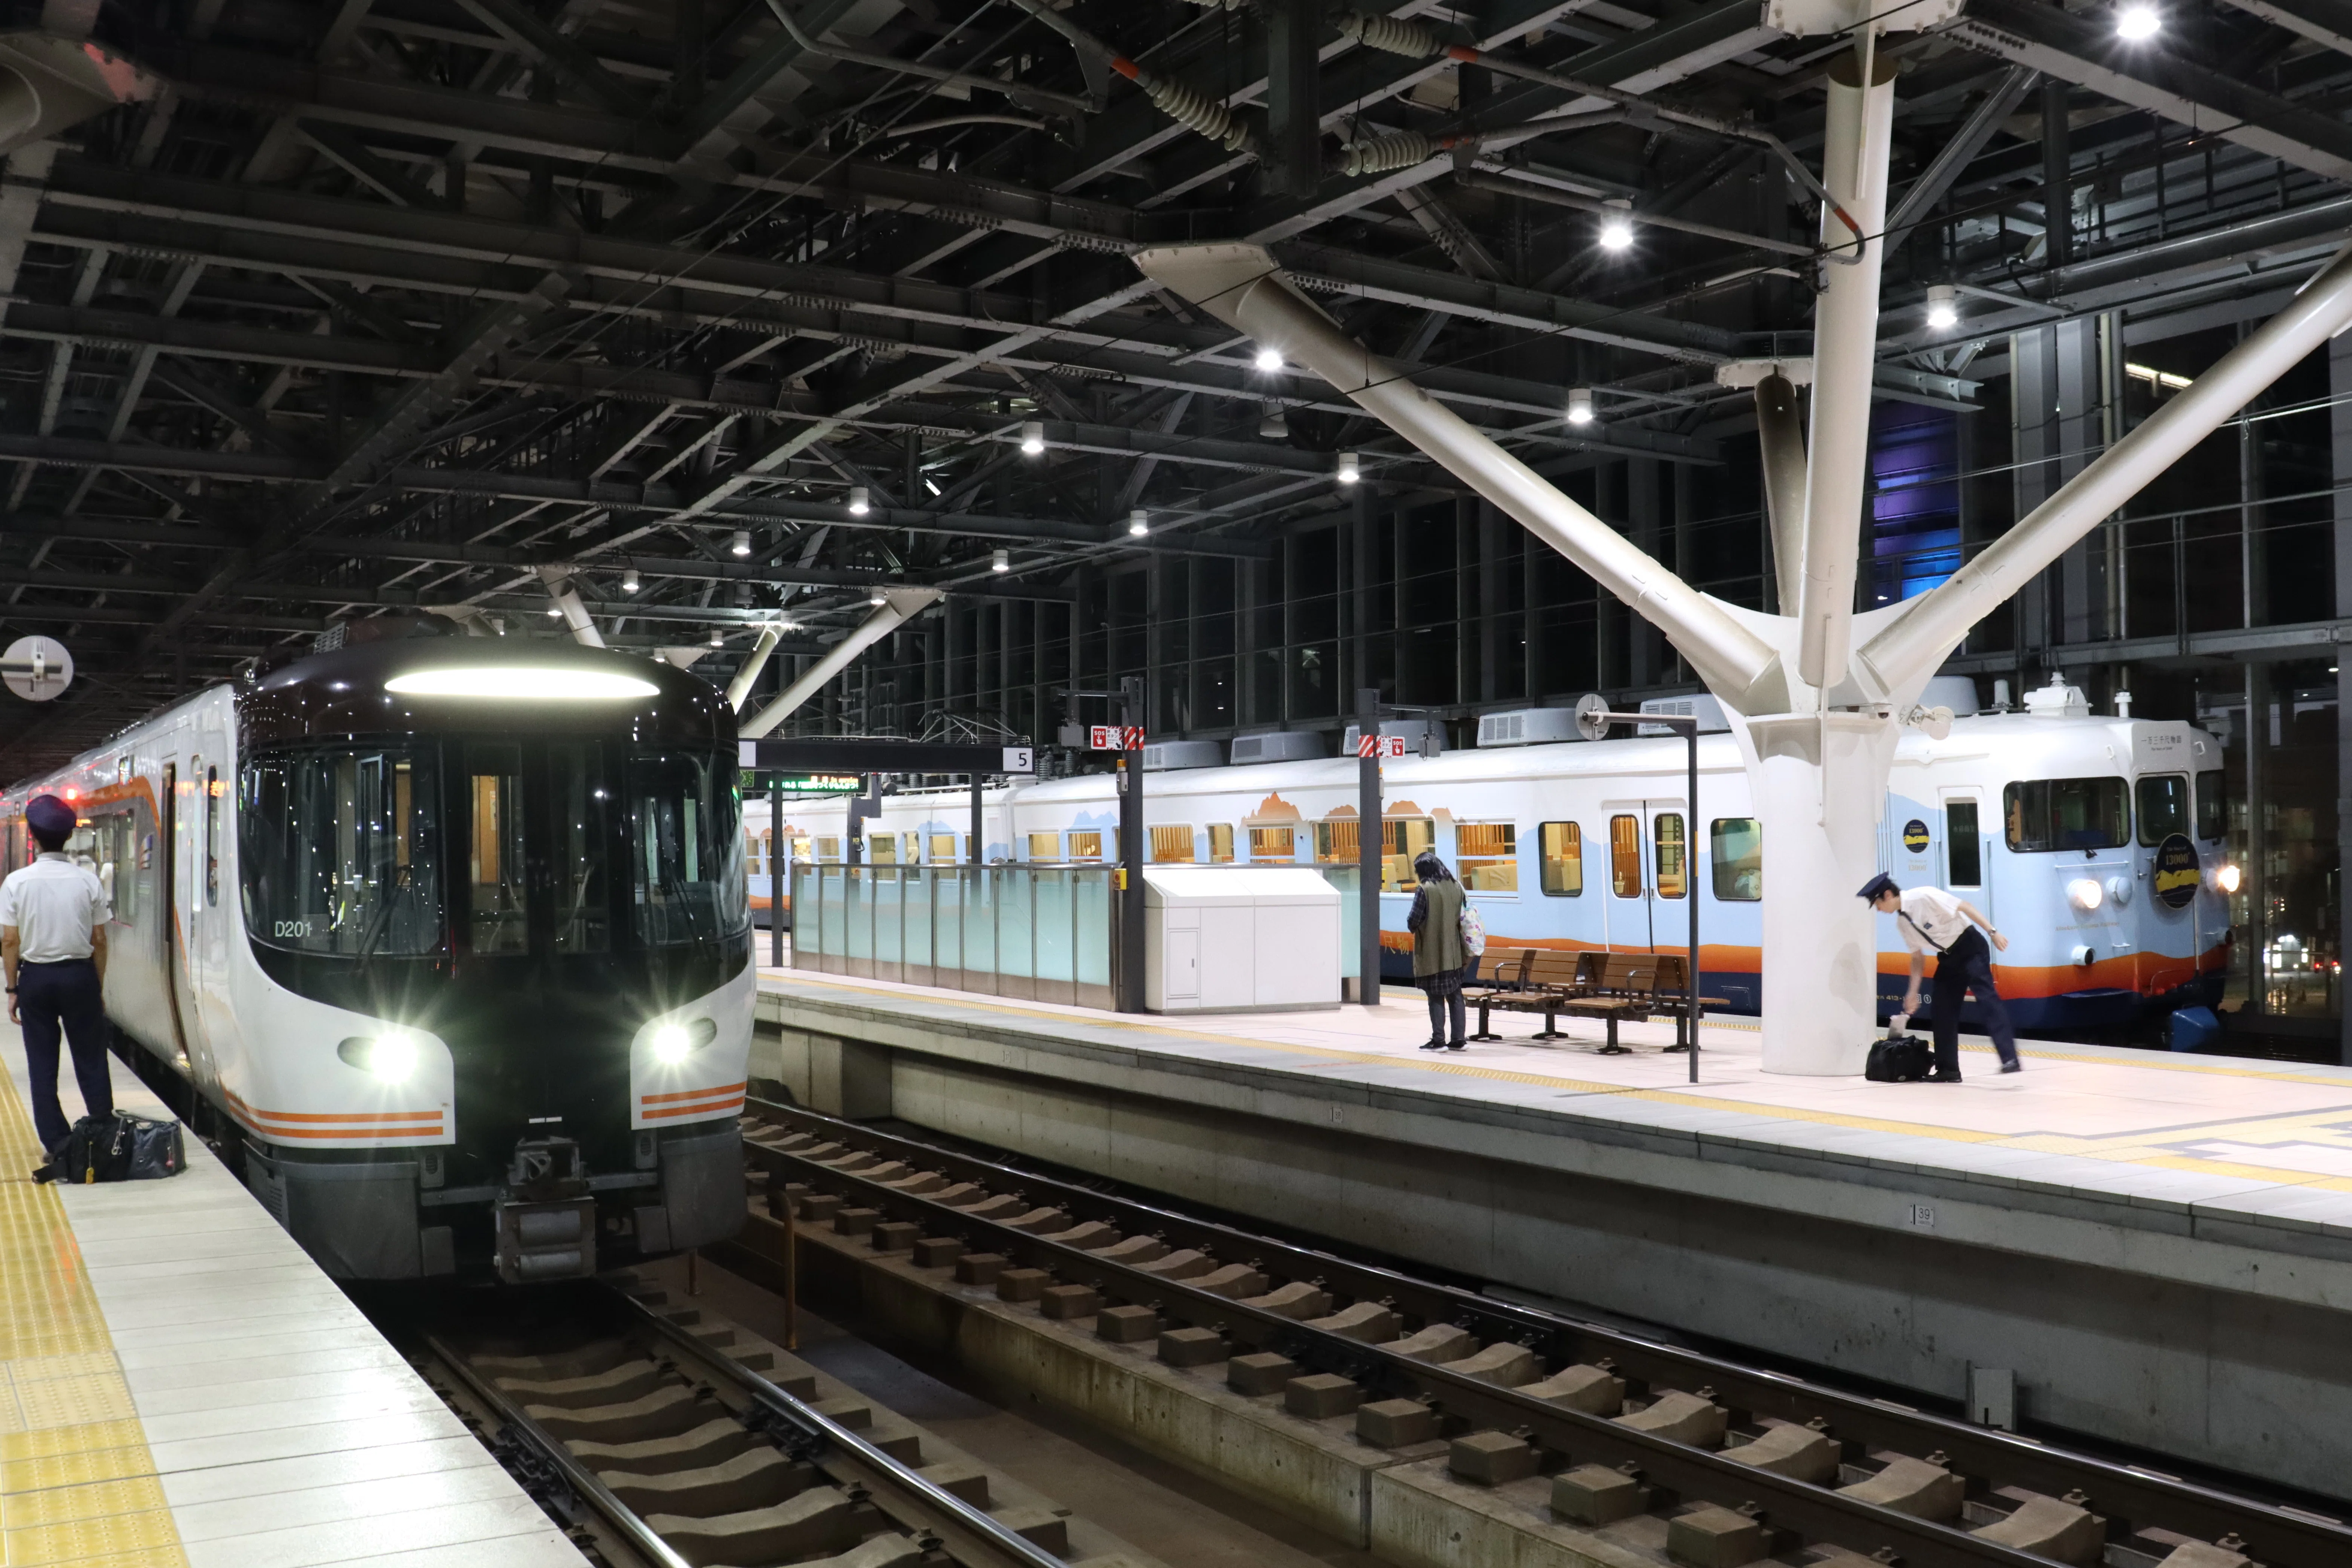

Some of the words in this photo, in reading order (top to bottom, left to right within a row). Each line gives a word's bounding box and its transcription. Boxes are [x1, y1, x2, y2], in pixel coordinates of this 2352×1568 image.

[1019, 753, 1027, 767] 5
[275, 921, 310, 937] D201
[1335, 1111, 1341, 1120] 38
[1919, 1208, 1930, 1220] 39
